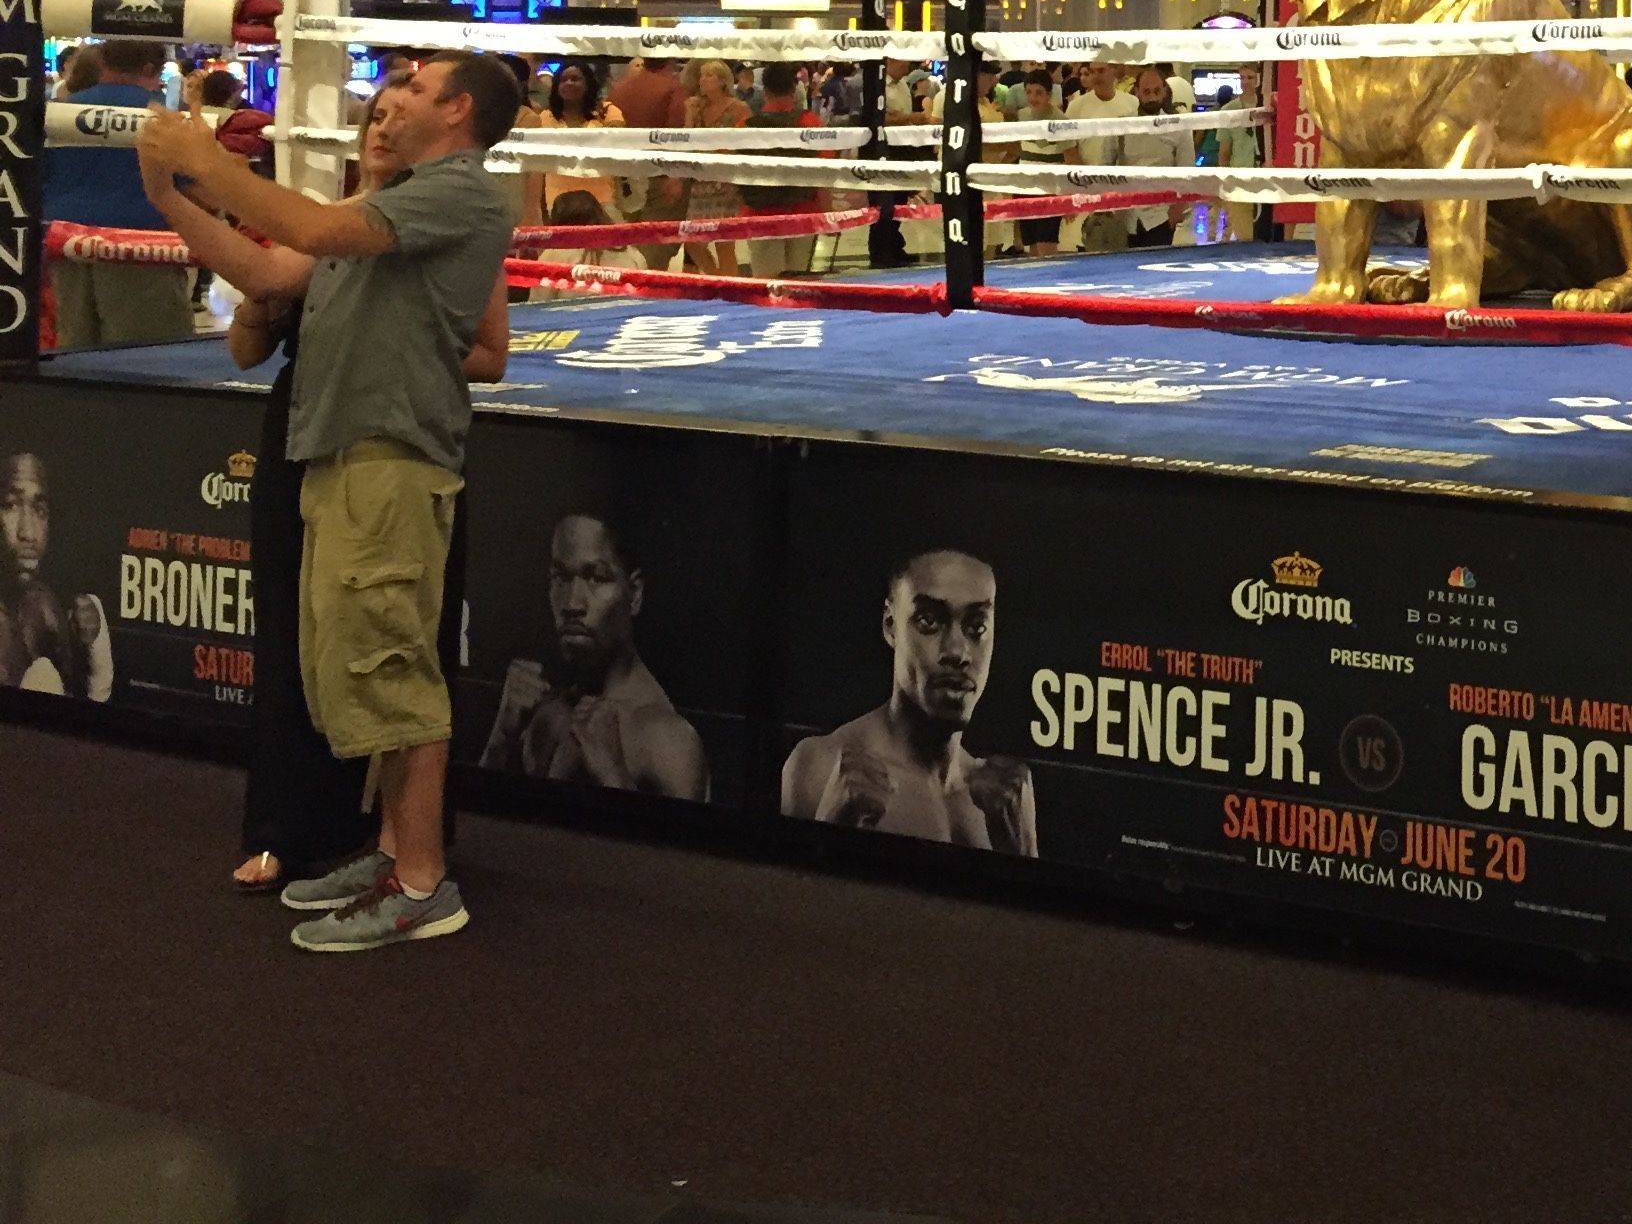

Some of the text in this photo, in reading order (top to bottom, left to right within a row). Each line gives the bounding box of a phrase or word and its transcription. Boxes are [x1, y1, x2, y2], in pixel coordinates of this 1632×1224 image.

[833, 32, 892, 51] Corona
[1042, 34, 1099, 52] Corona
[1276, 29, 1342, 50] Corona
[1532, 23, 1603, 42] Corona
[75, 108, 140, 139] Cor
[1067, 170, 1128, 186] Corona
[1304, 174, 1373, 192] Corona
[63, 235, 189, 263] Corona
[1445, 307, 1517, 331] Corona
[201, 472, 251, 509] Cor
[1406, 480, 1534, 497] platform
[1230, 578, 1354, 625] Corona
[1427, 590, 1496, 608] PREMIER
[1406, 608, 1519, 634] BOXING
[1101, 640, 1152, 673] ERROL
[1416, 633, 1508, 655] CHAMPIONS
[193, 644, 255, 686] SATUR
[1330, 647, 1415, 674] PRESENTS
[215, 685, 245, 706] LIVE
[1449, 683, 1535, 721] ROBERTO
[1030, 668, 1321, 786] SPENCE JR.
[1357, 736, 1386, 772] VS
[1222, 794, 1378, 859] SATURDAY
[1401, 820, 1476, 876] JUNE
[1485, 832, 1527, 883] 20
[1255, 847, 1302, 873] LIVE
[1309, 855, 1335, 877] AT
[1339, 863, 1395, 888] MGM
[1402, 871, 1483, 902] GRAND
